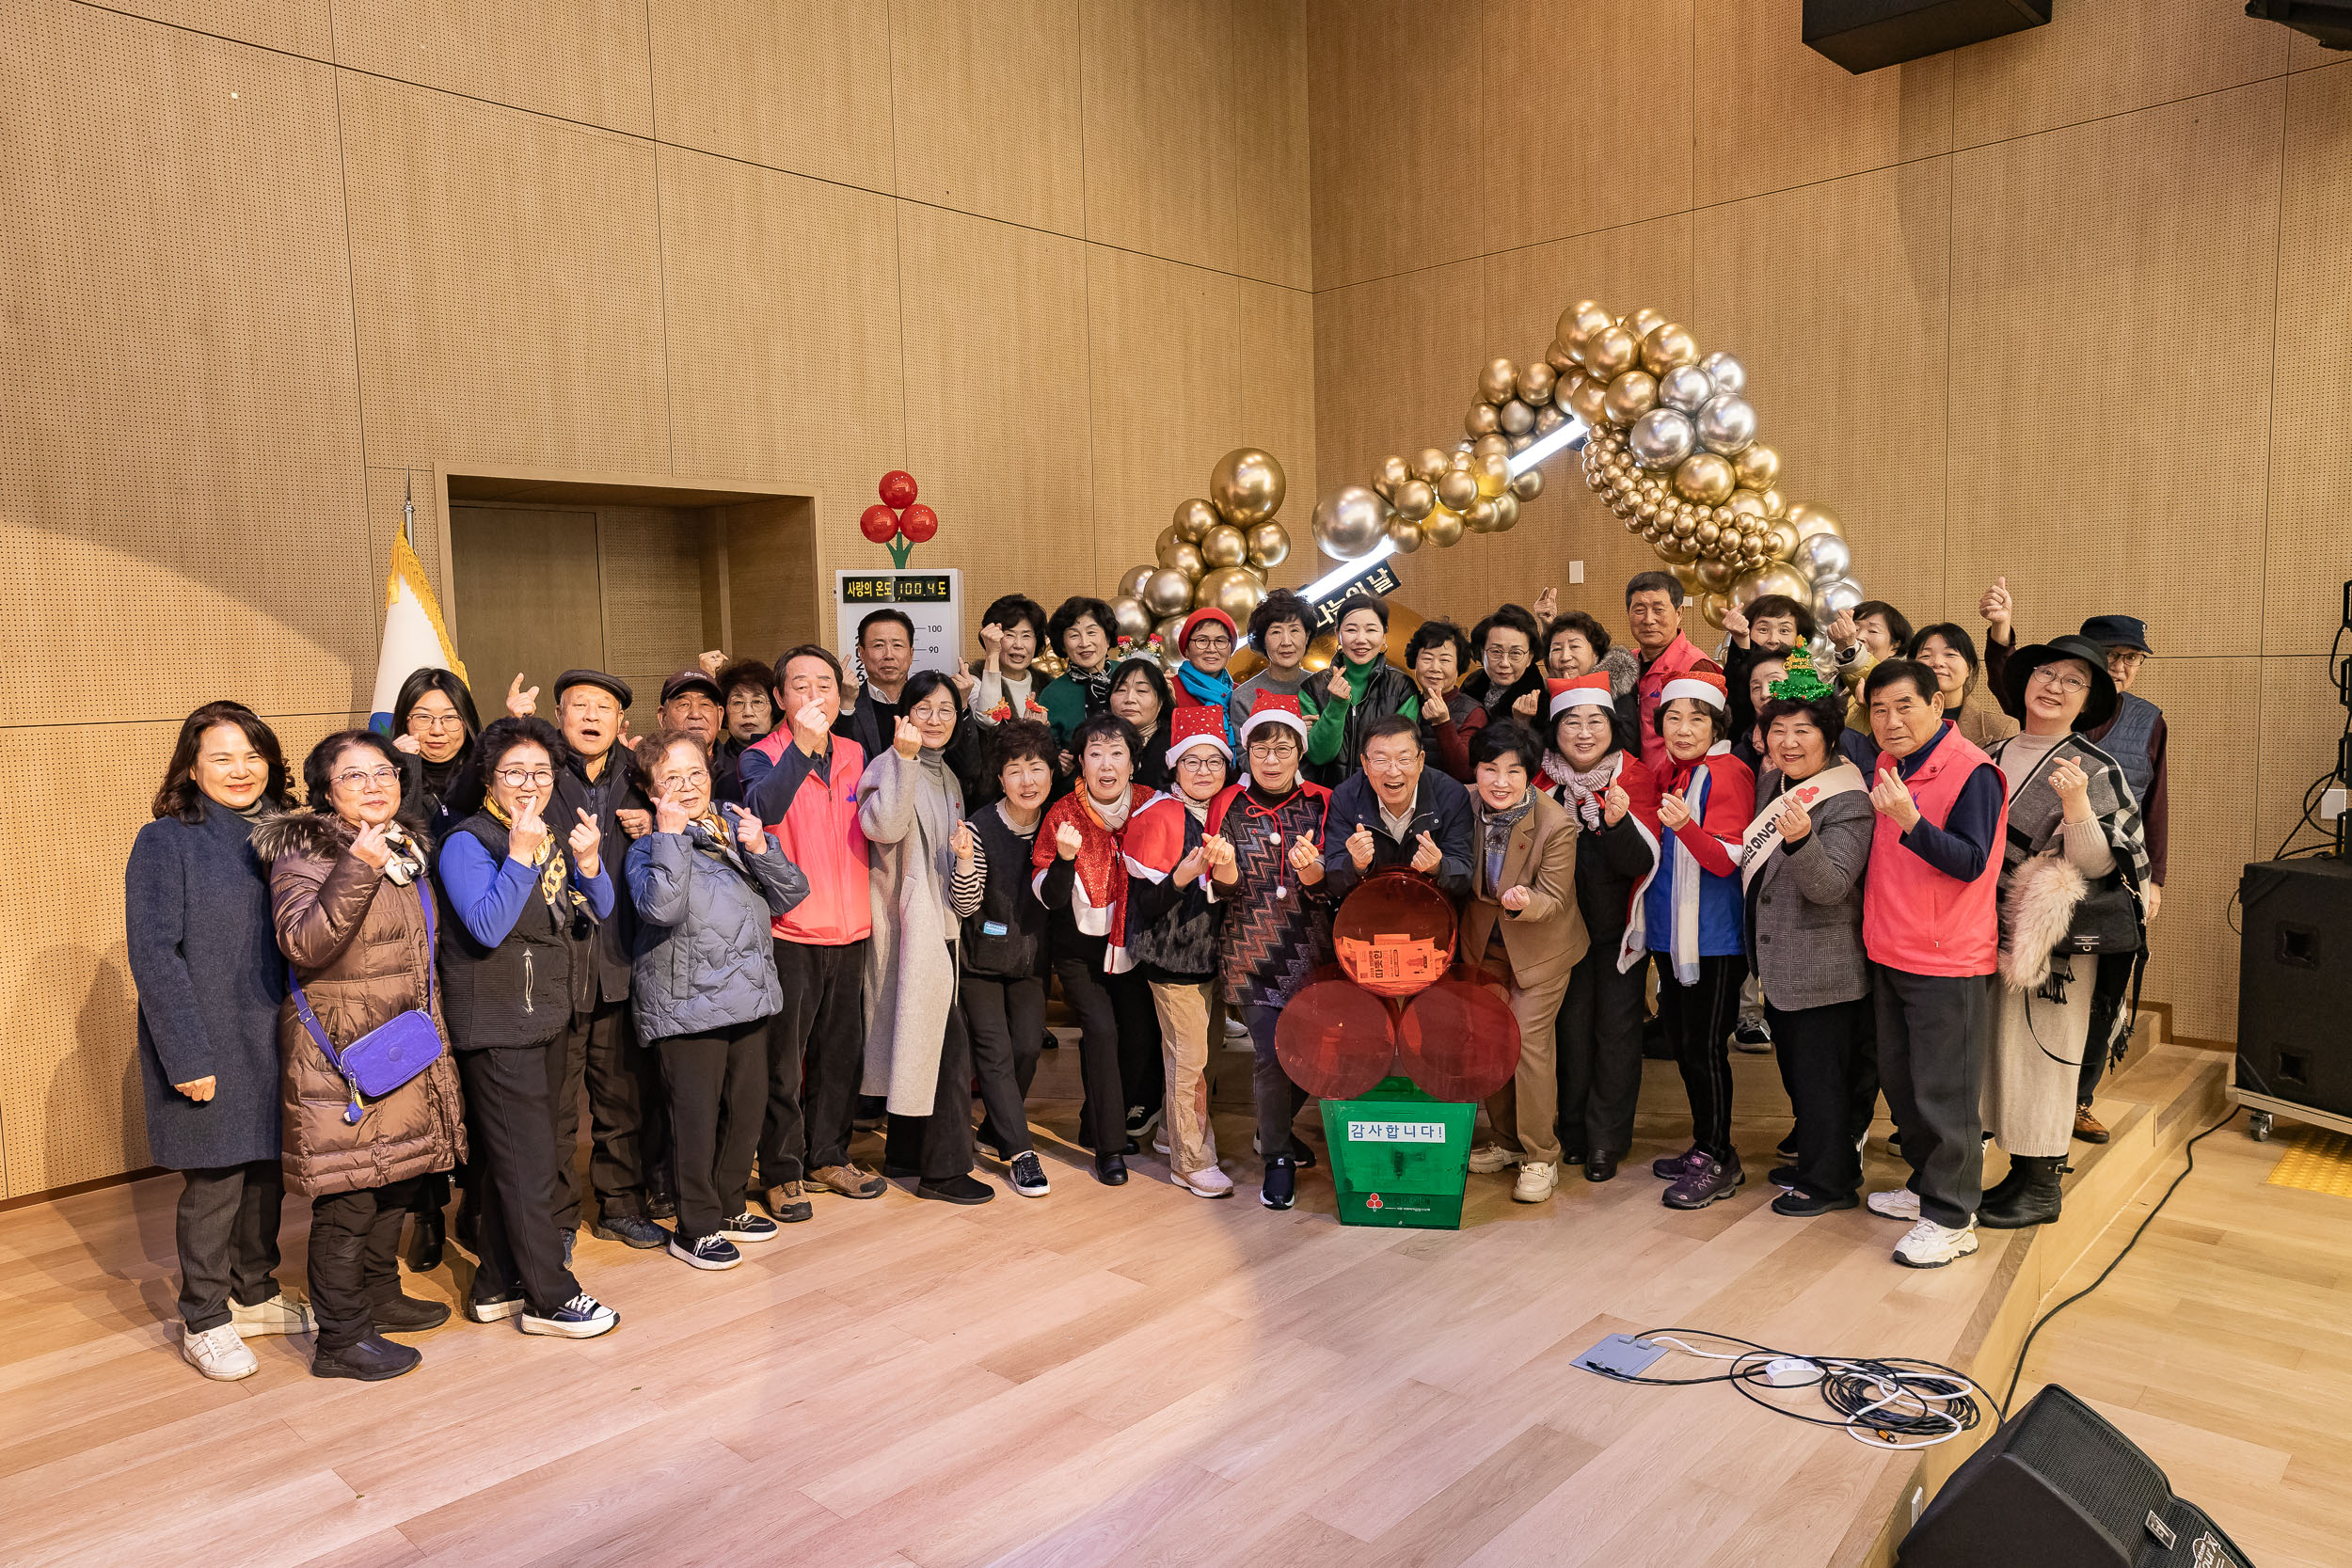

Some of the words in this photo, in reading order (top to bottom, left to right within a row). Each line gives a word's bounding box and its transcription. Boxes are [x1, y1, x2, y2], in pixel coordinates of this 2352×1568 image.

[848, 580, 872, 597] 사랑의
[875, 581, 892, 596] 온도
[899, 582, 935, 596] 100.4
[937, 581, 946, 595] 도
[1366, 567, 1394, 594] 날
[928, 625, 942, 633] 100
[929, 645, 939, 654] 90
[1374, 950, 1384, 978] 따뜻한
[1351, 1124, 1442, 1139] 감사합니다!
